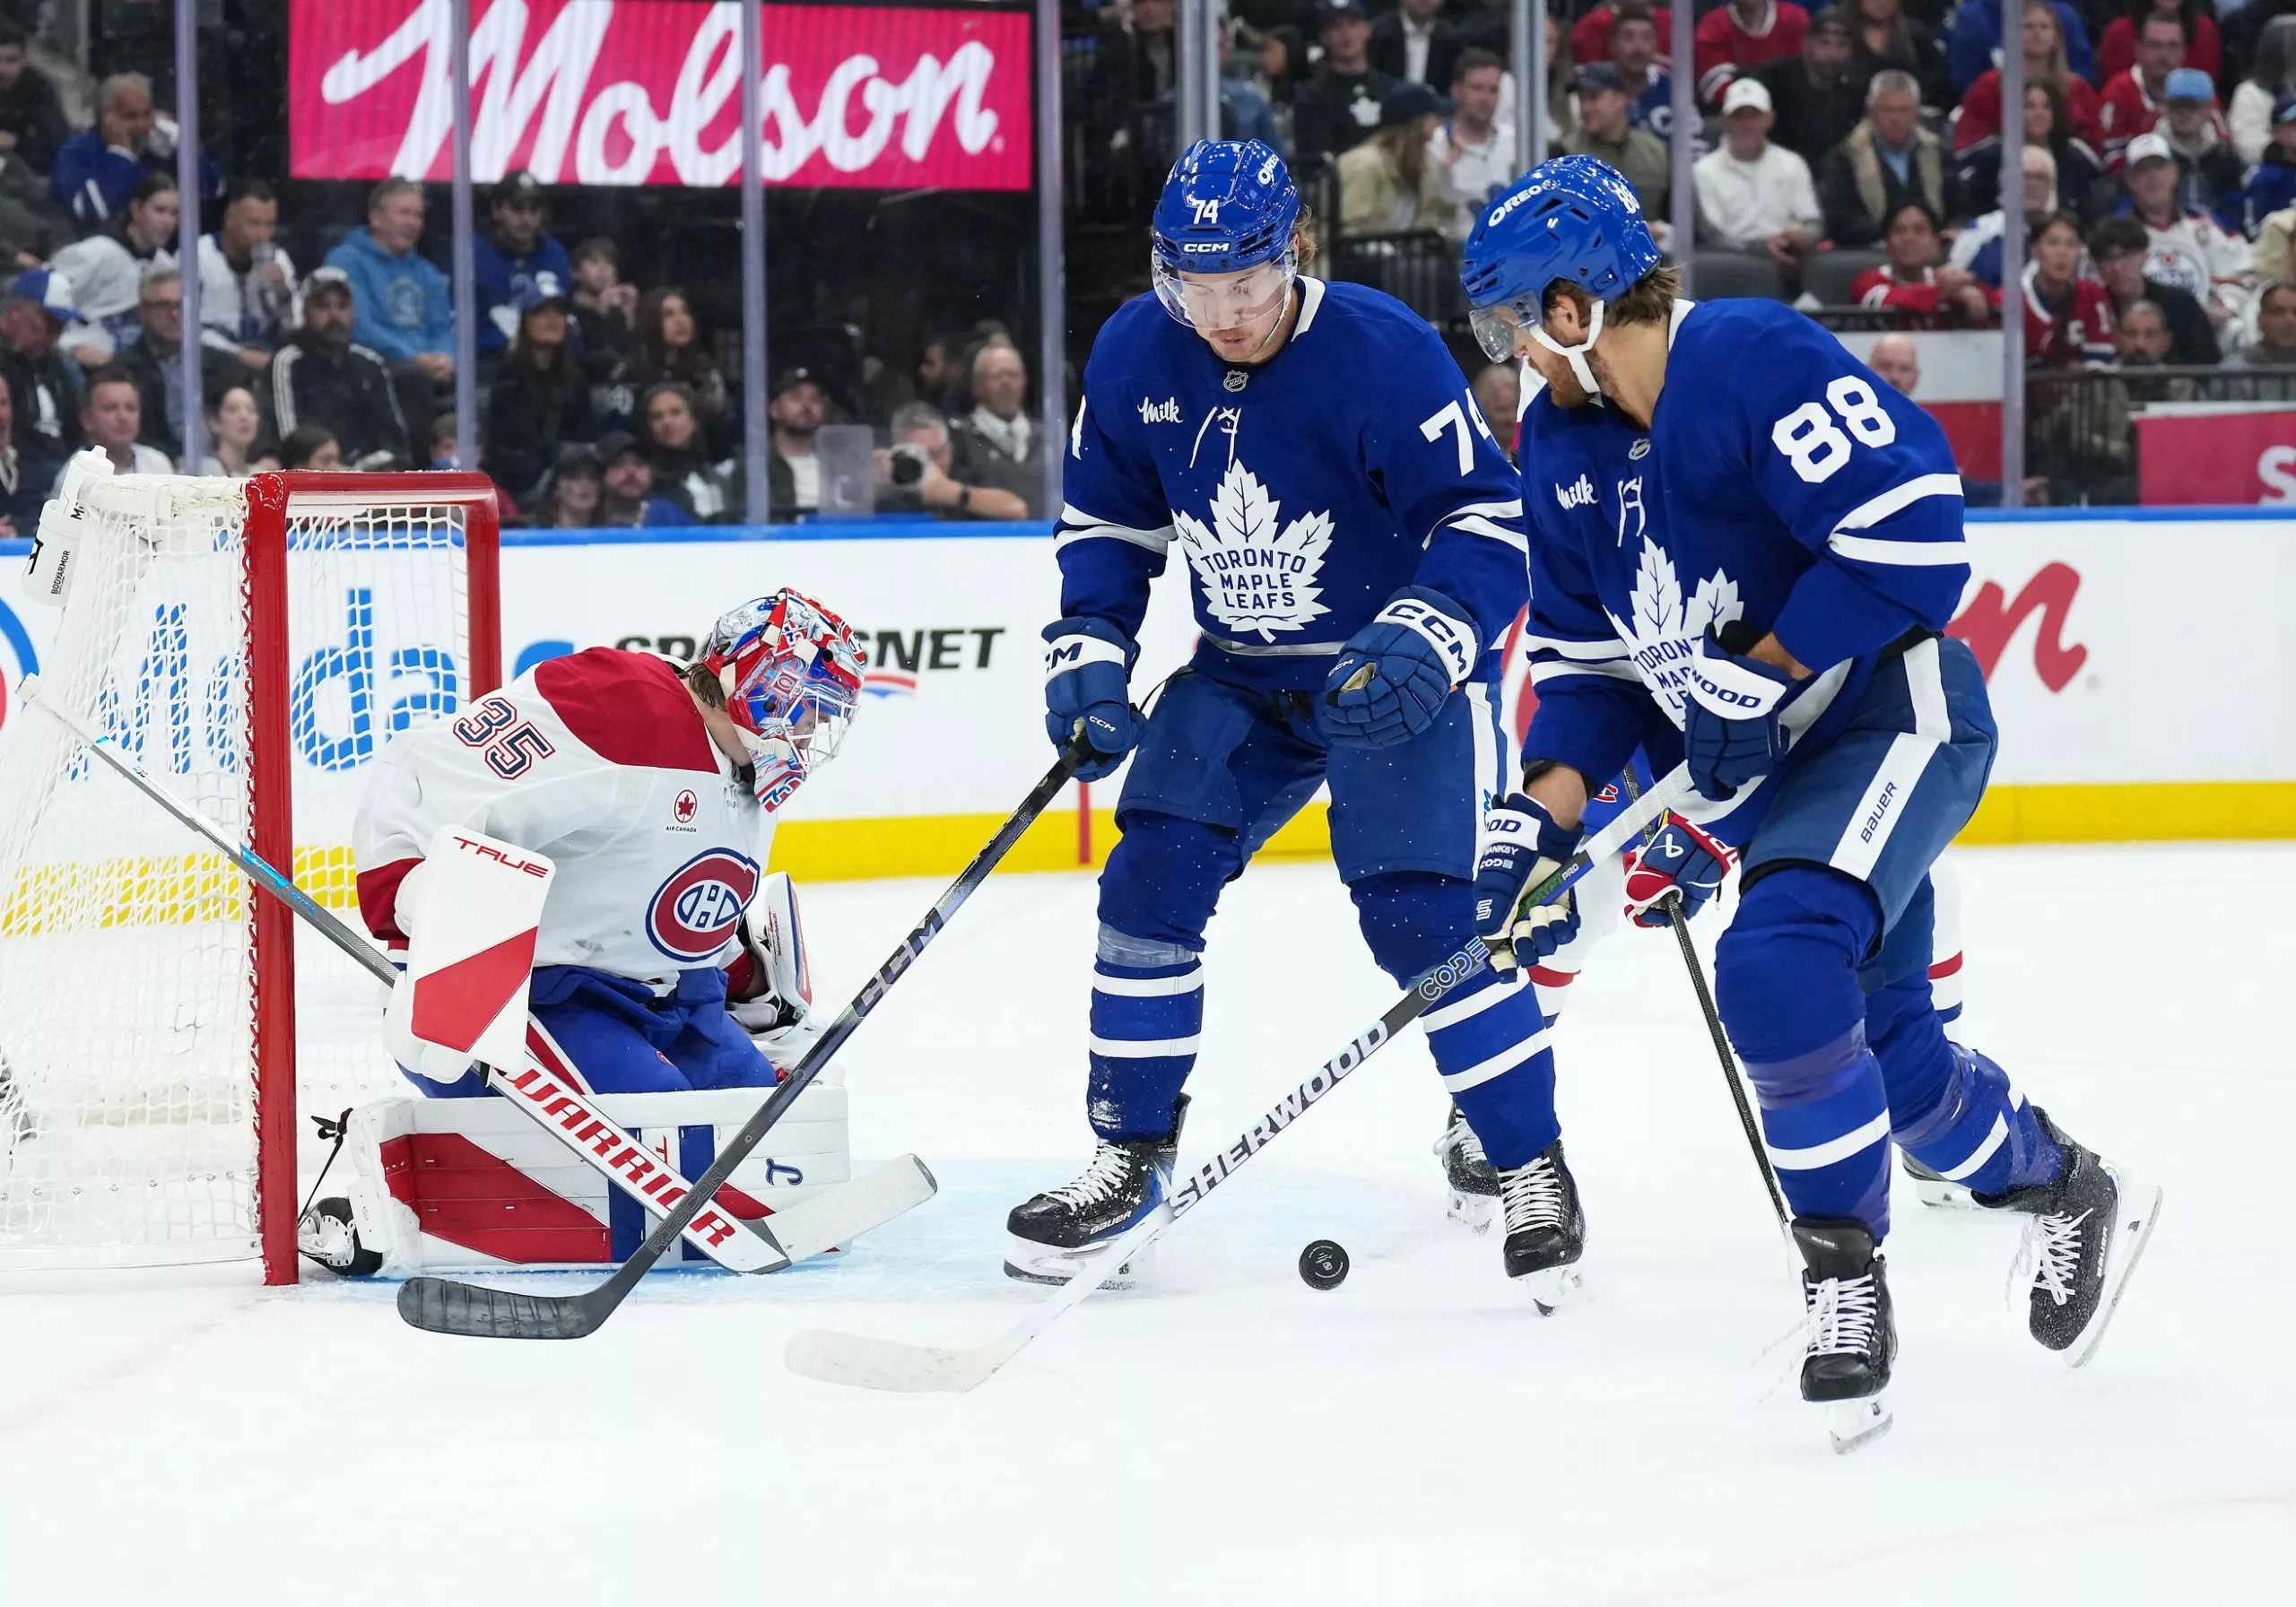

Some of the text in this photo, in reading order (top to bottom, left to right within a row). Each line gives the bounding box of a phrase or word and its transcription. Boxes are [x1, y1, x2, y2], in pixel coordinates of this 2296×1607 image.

[322, 0, 997, 187] Molson
[1193, 199, 1219, 224] 74
[1488, 185, 1543, 227] OREO
[1184, 243, 1230, 252] CCM
[1137, 396, 1184, 424] Milk
[1771, 375, 1896, 483] 88
[1555, 473, 1599, 510] Milk
[51, 550, 71, 595] BODYARMOR
[1200, 548, 1307, 574] TORONTO
[1220, 573, 1292, 591] MAPLE
[1223, 591, 1296, 610] LEAFS
[1387, 604, 1467, 674] CCM
[1633, 636, 1704, 674] TORON
[1653, 666, 1692, 689] MAP
[453, 698, 555, 780] 35
[1089, 716, 1117, 733] CCM
[453, 836, 549, 878] TRUE
[1561, 863, 1580, 881] PRO
[852, 907, 944, 1017] CCM
[1419, 935, 1491, 1001] CODE
[1169, 1020, 1388, 1218] SHERWOOD
[1089, 1210, 1132, 1236] BAUER
